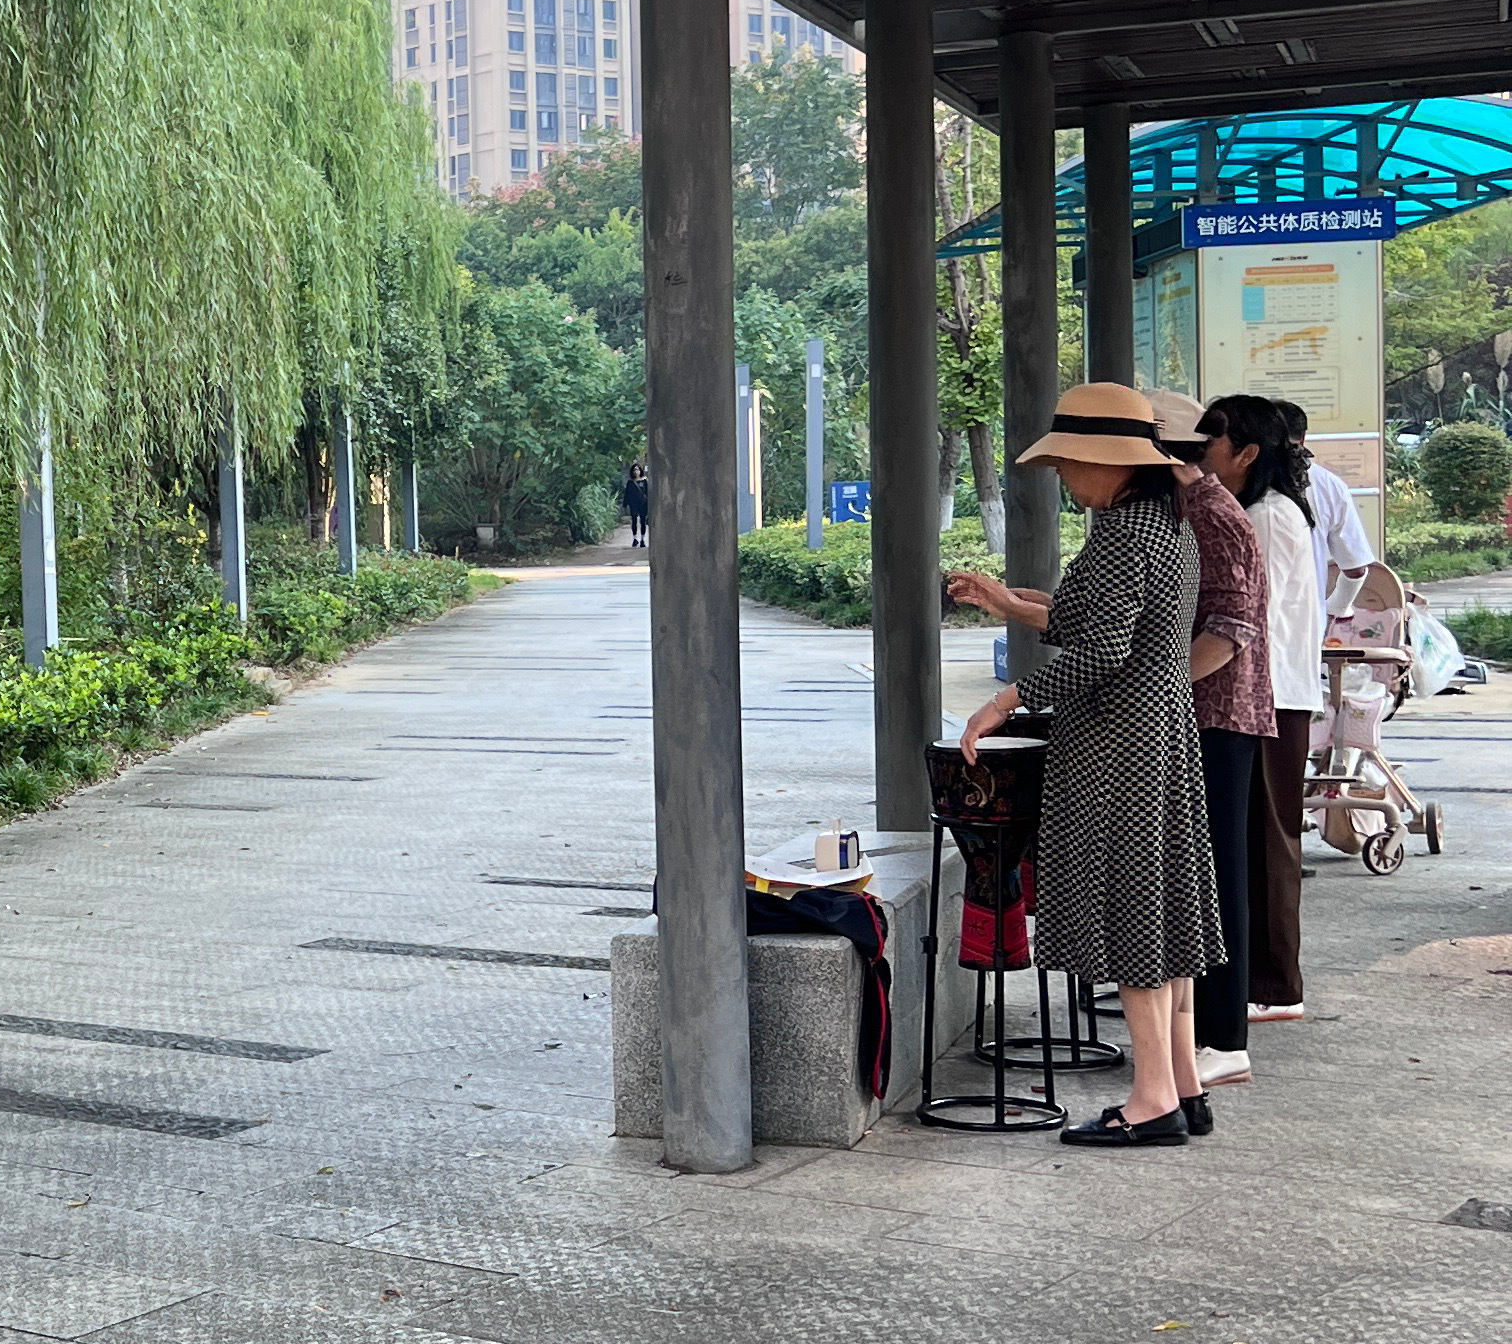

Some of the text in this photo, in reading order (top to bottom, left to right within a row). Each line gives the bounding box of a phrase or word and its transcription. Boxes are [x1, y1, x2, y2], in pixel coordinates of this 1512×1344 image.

[1196, 208, 1383, 237] 智能公共体质检测站
